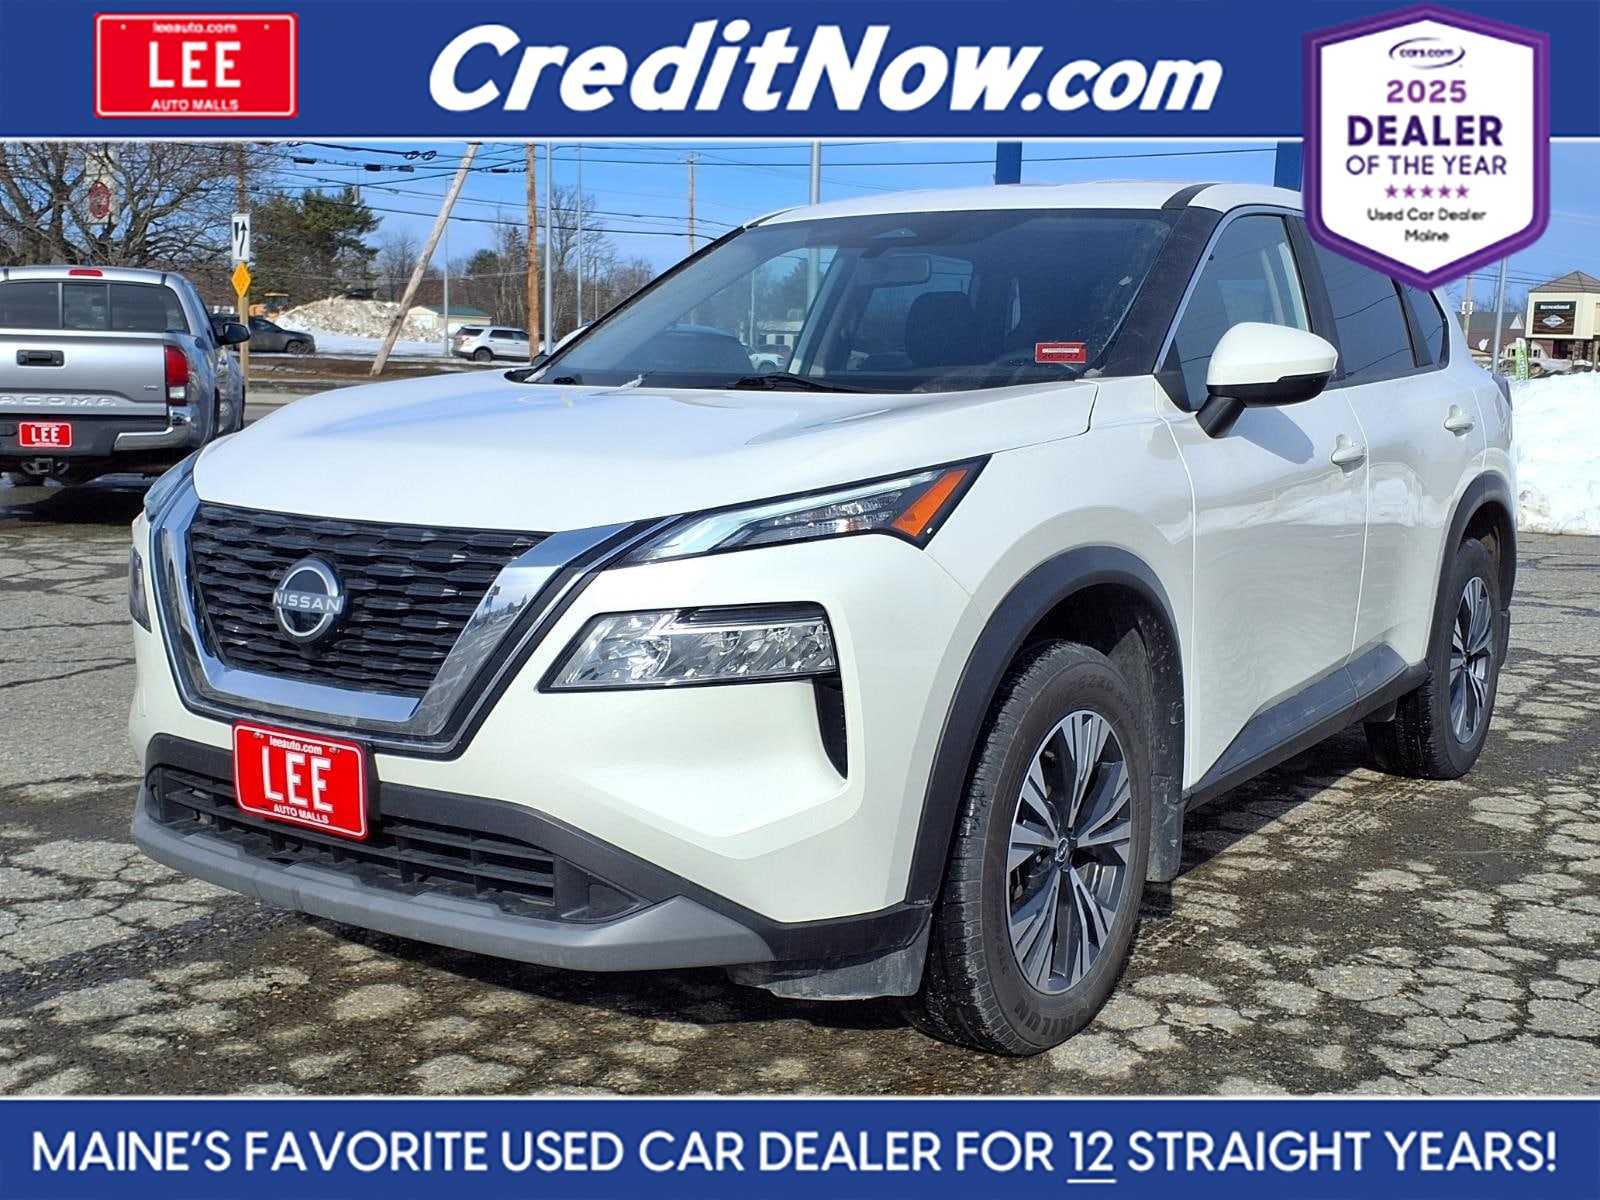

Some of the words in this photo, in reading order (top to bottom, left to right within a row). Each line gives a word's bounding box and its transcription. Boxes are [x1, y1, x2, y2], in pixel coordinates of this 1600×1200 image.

[31, 427, 61, 442] LEE
[272, 591, 341, 612] NISSAN
[269, 736, 323, 755] leeauto.com
[262, 745, 334, 813] LEE
[273, 803, 298, 818] AUTO
[299, 809, 330, 825] MALLS
